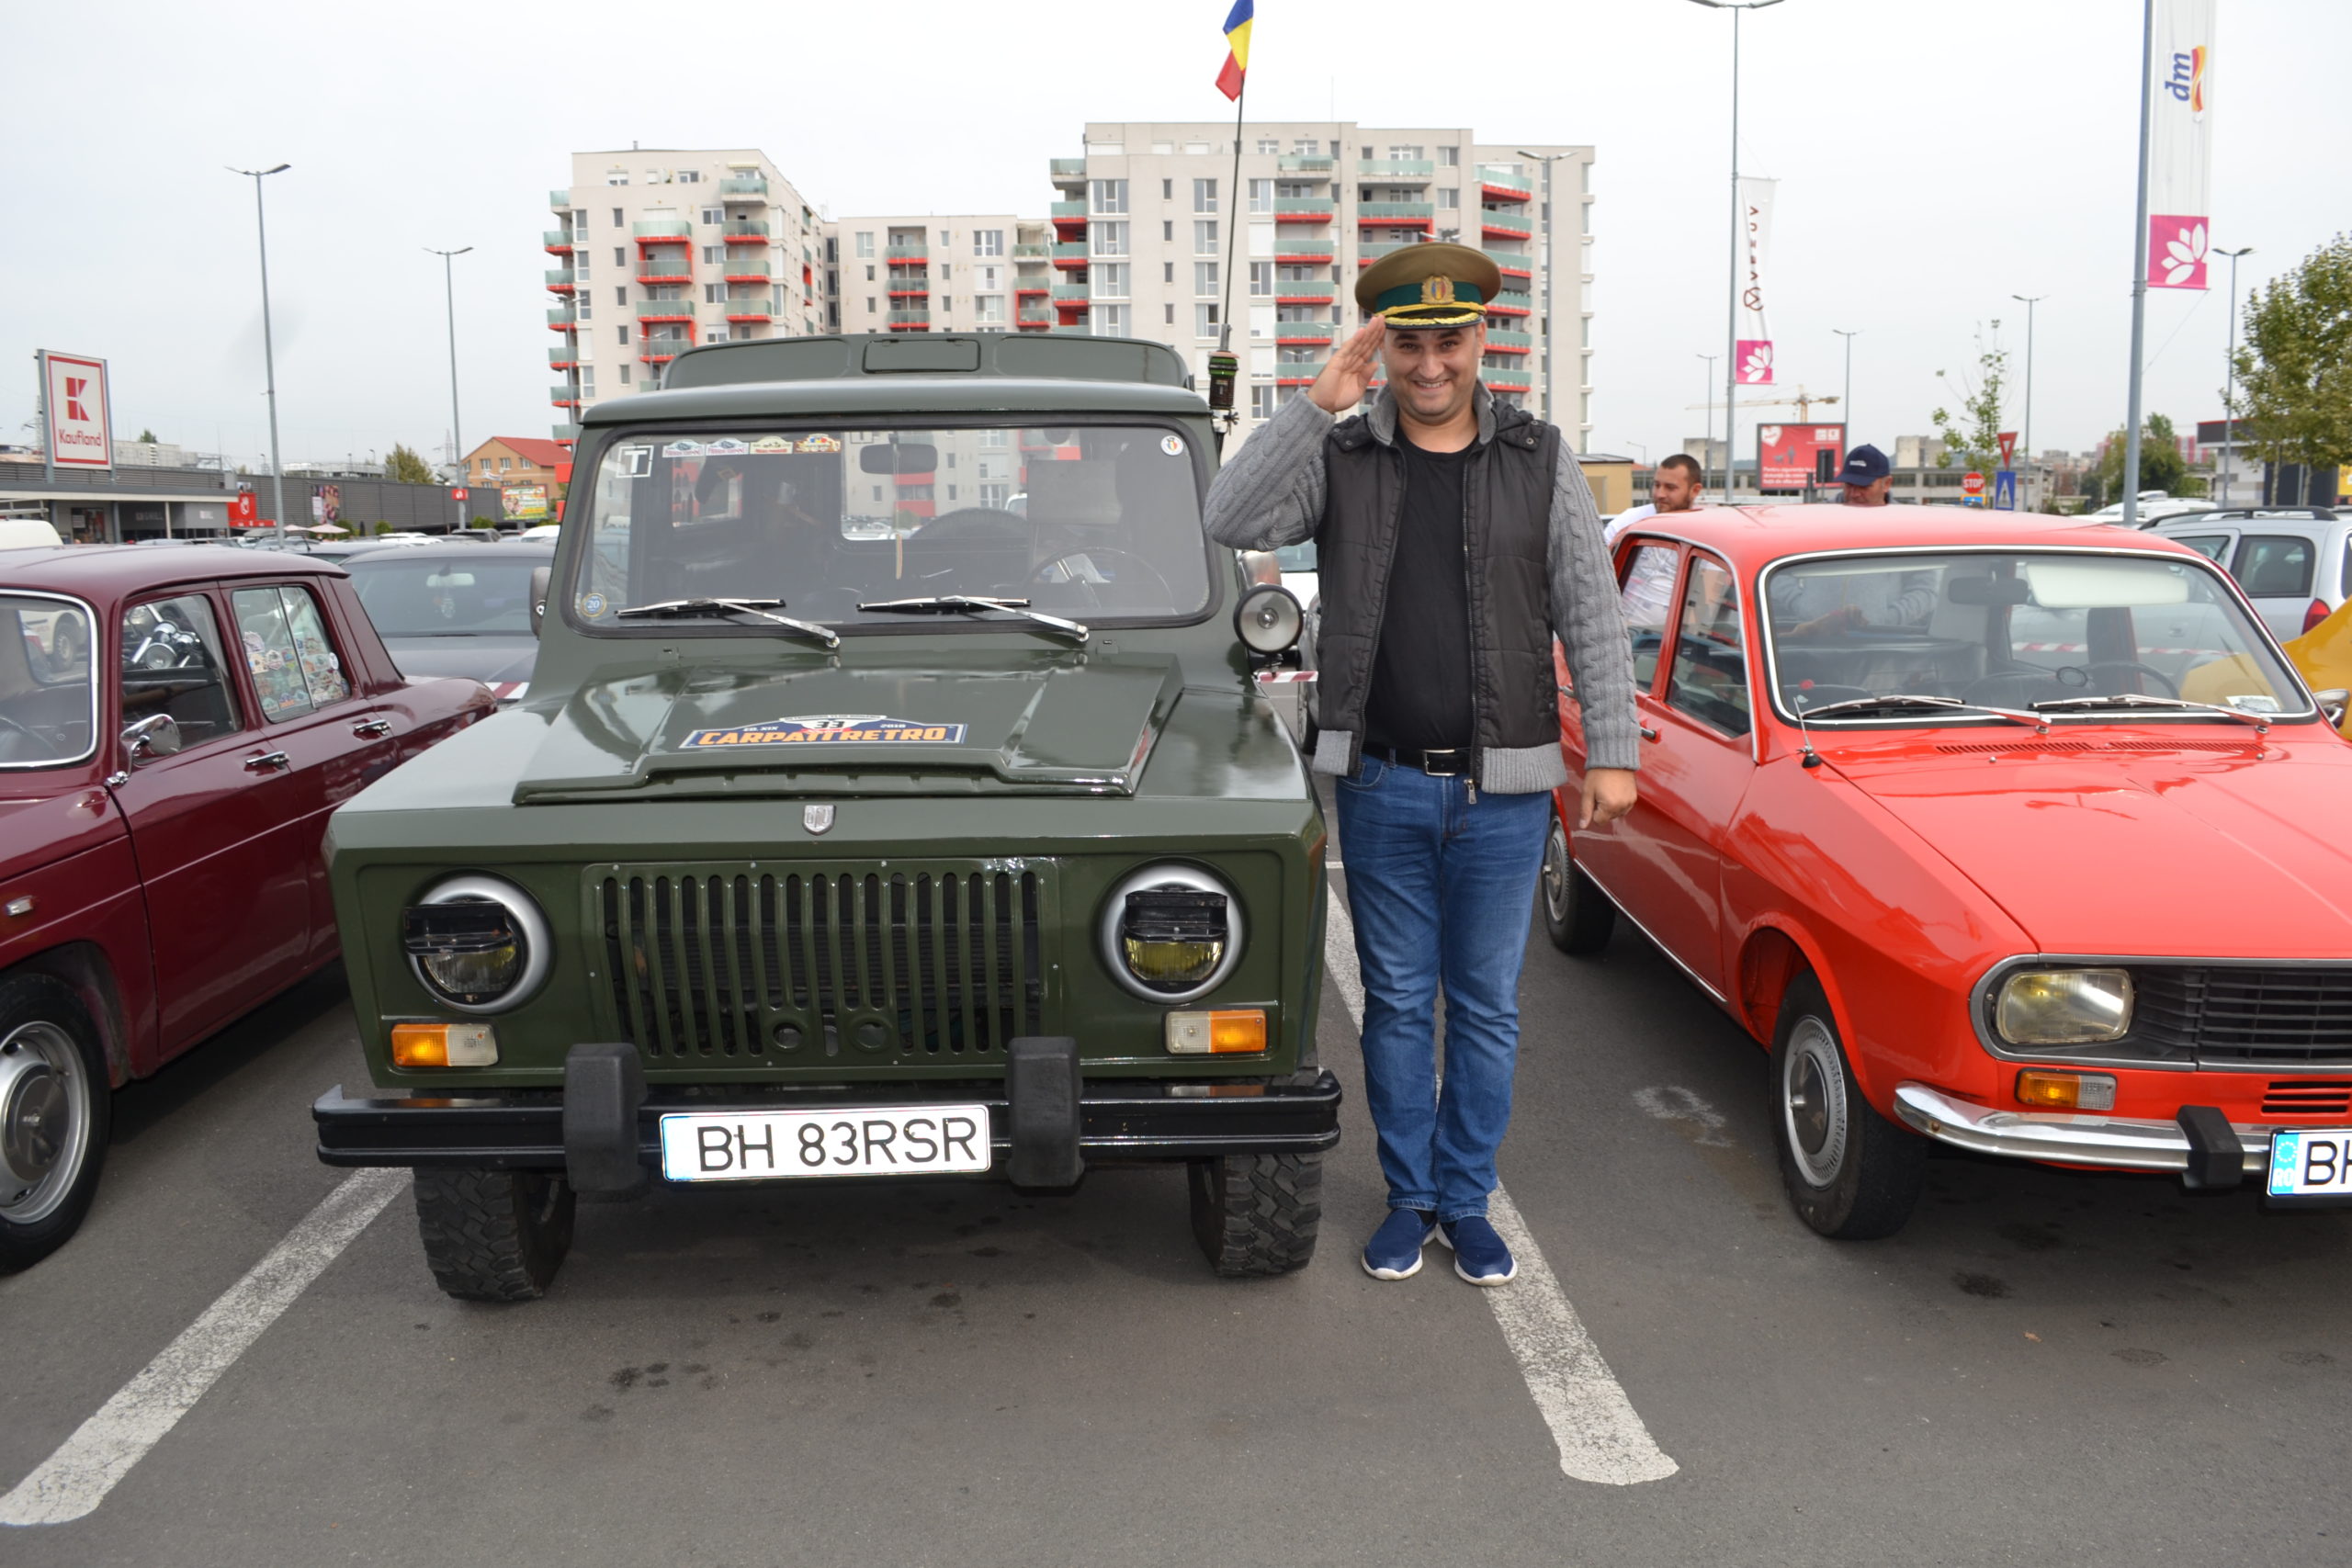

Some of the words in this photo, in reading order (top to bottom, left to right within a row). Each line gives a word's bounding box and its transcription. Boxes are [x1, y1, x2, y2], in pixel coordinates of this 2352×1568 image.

[2165, 52, 2190, 101] dm
[66, 377, 90, 422] K
[59, 428, 102, 446] Kaufland
[625, 450, 648, 474] T
[1962, 478, 1984, 489] STOP
[814, 720, 845, 728] 33
[697, 730, 838, 745] CARPATI
[838, 727, 947, 741] RETRO
[697, 1123, 775, 1172] BH
[797, 1117, 977, 1168] 83RSR
[2272, 1168, 2295, 1187] RO
